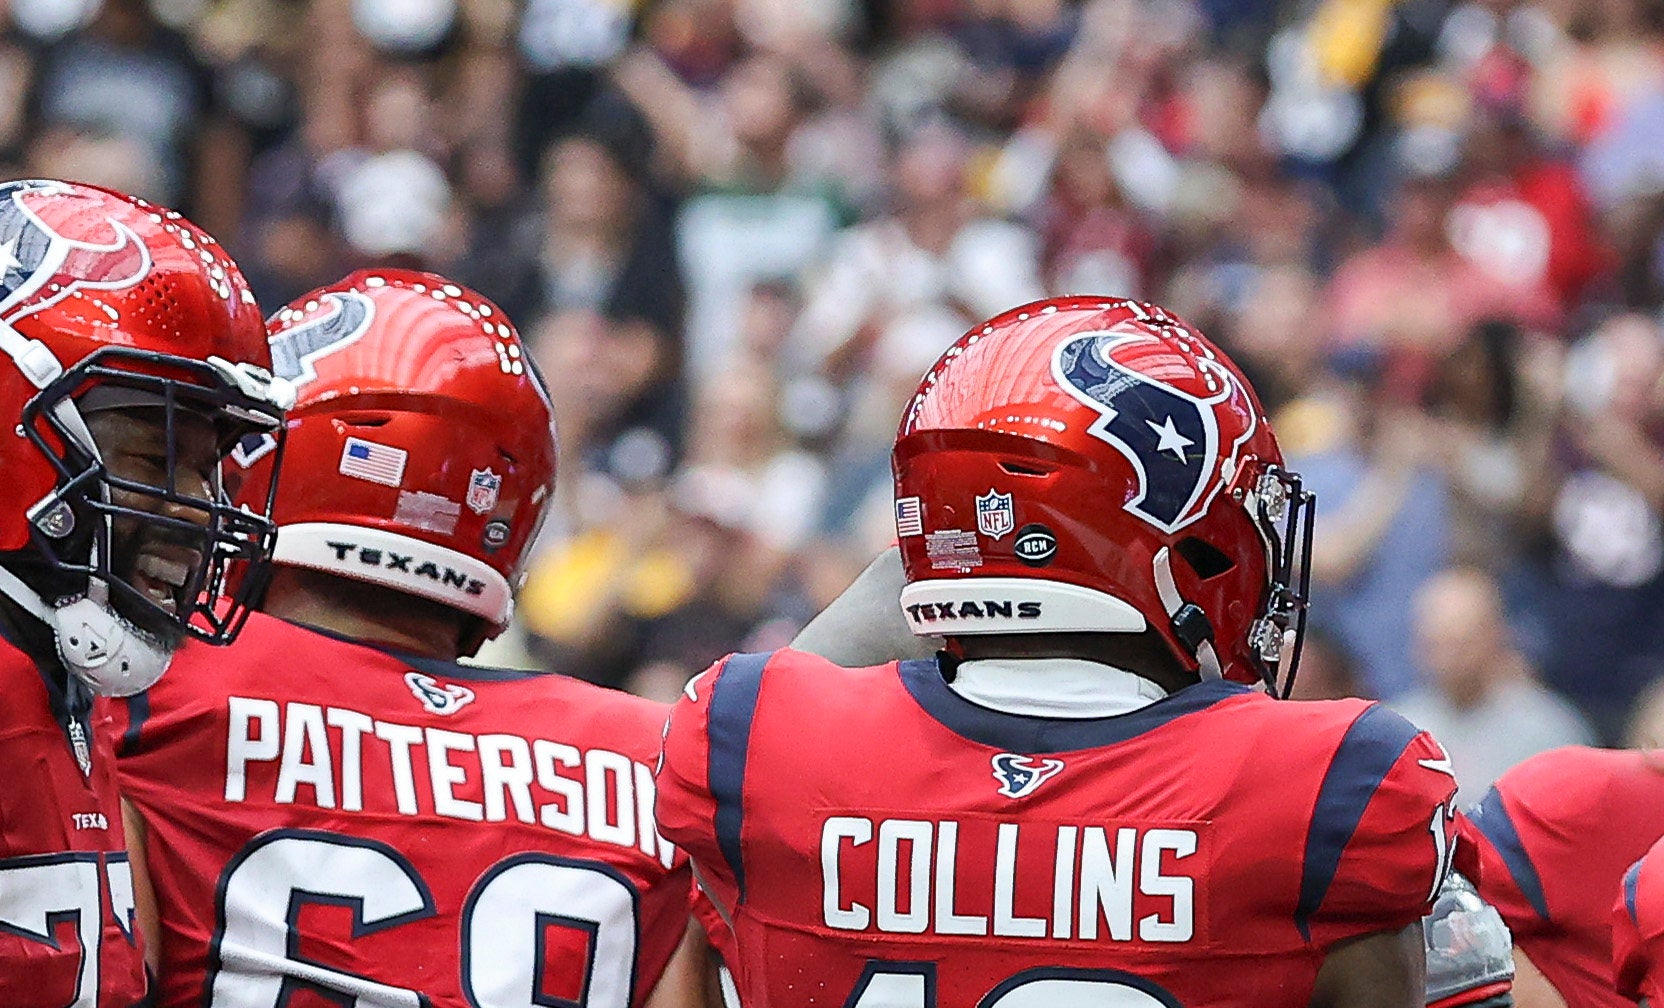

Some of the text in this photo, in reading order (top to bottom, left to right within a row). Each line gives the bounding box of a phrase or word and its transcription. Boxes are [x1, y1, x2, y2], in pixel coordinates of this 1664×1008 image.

[982, 512, 1009, 531] NFL
[326, 540, 487, 596] TEXANS
[906, 601, 1042, 624] TEXANS
[820, 815, 1198, 943] COLLINS
